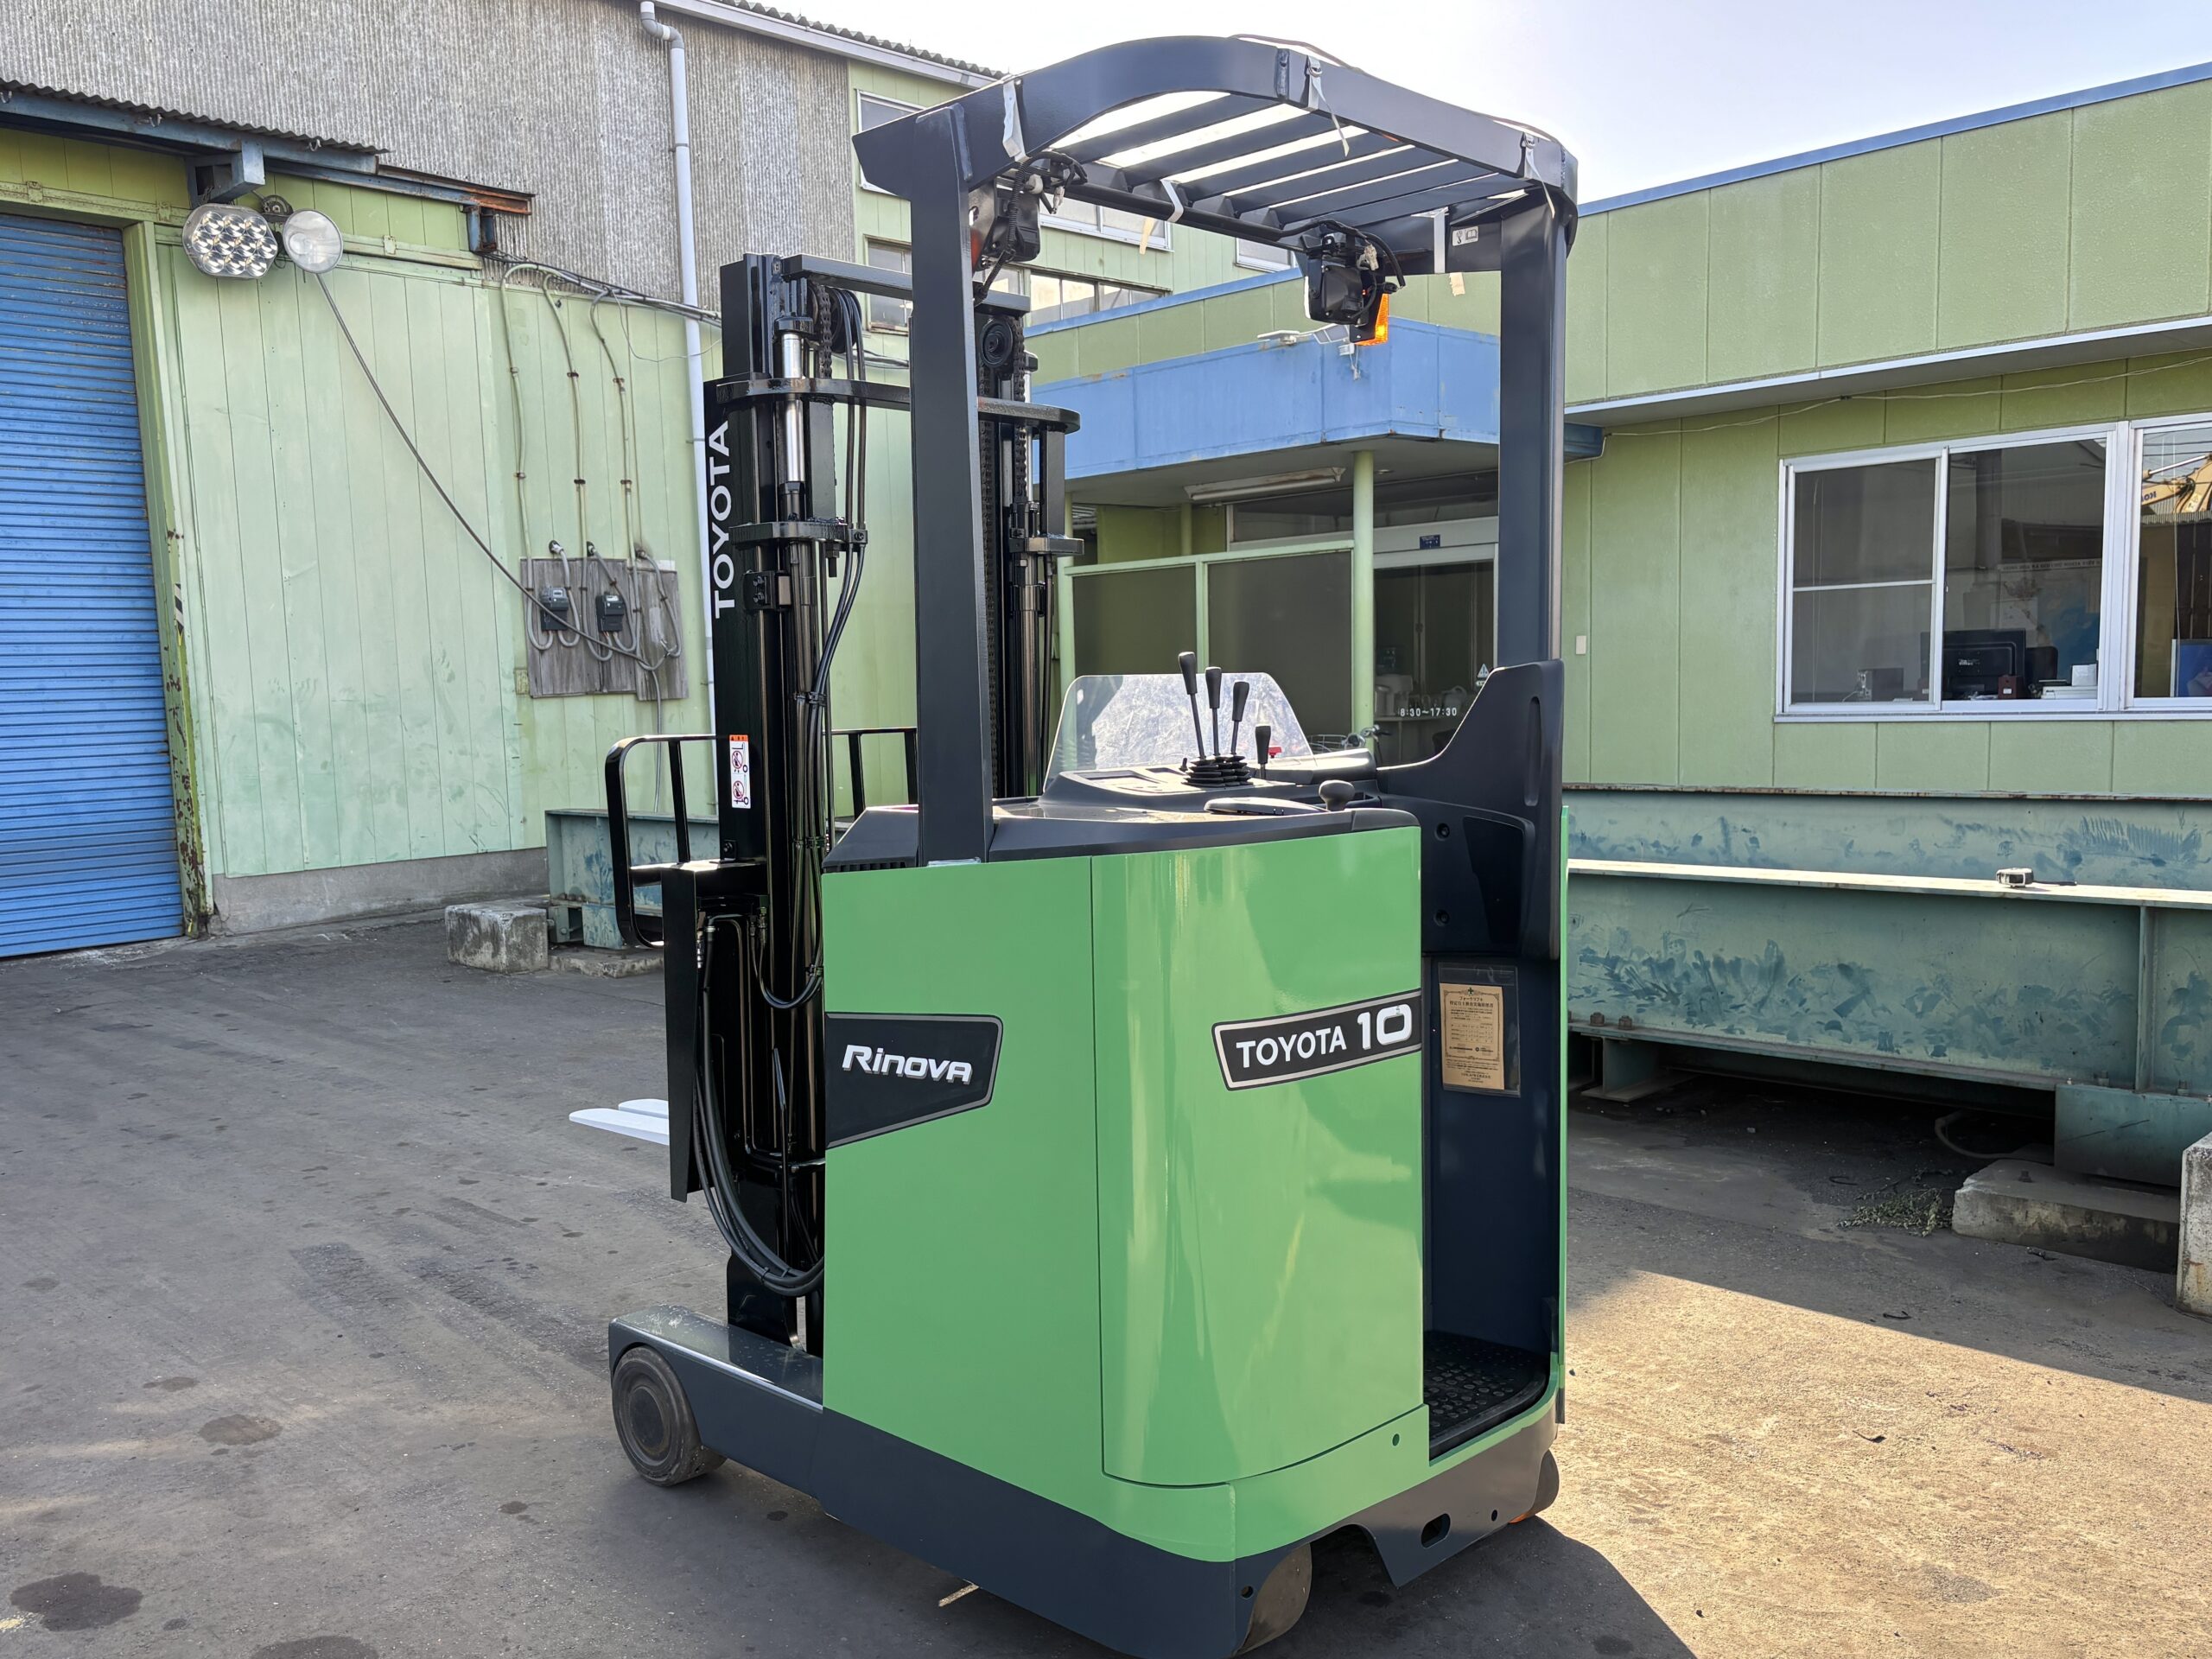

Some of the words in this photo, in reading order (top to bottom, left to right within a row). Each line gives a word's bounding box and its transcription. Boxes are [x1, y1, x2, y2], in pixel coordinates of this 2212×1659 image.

[709, 420, 735, 620] TOYOTA
[842, 1044, 973, 1085] Rinova
[1236, 1026, 1347, 1069] TOYOTA
[1357, 1003, 1413, 1051] 10
